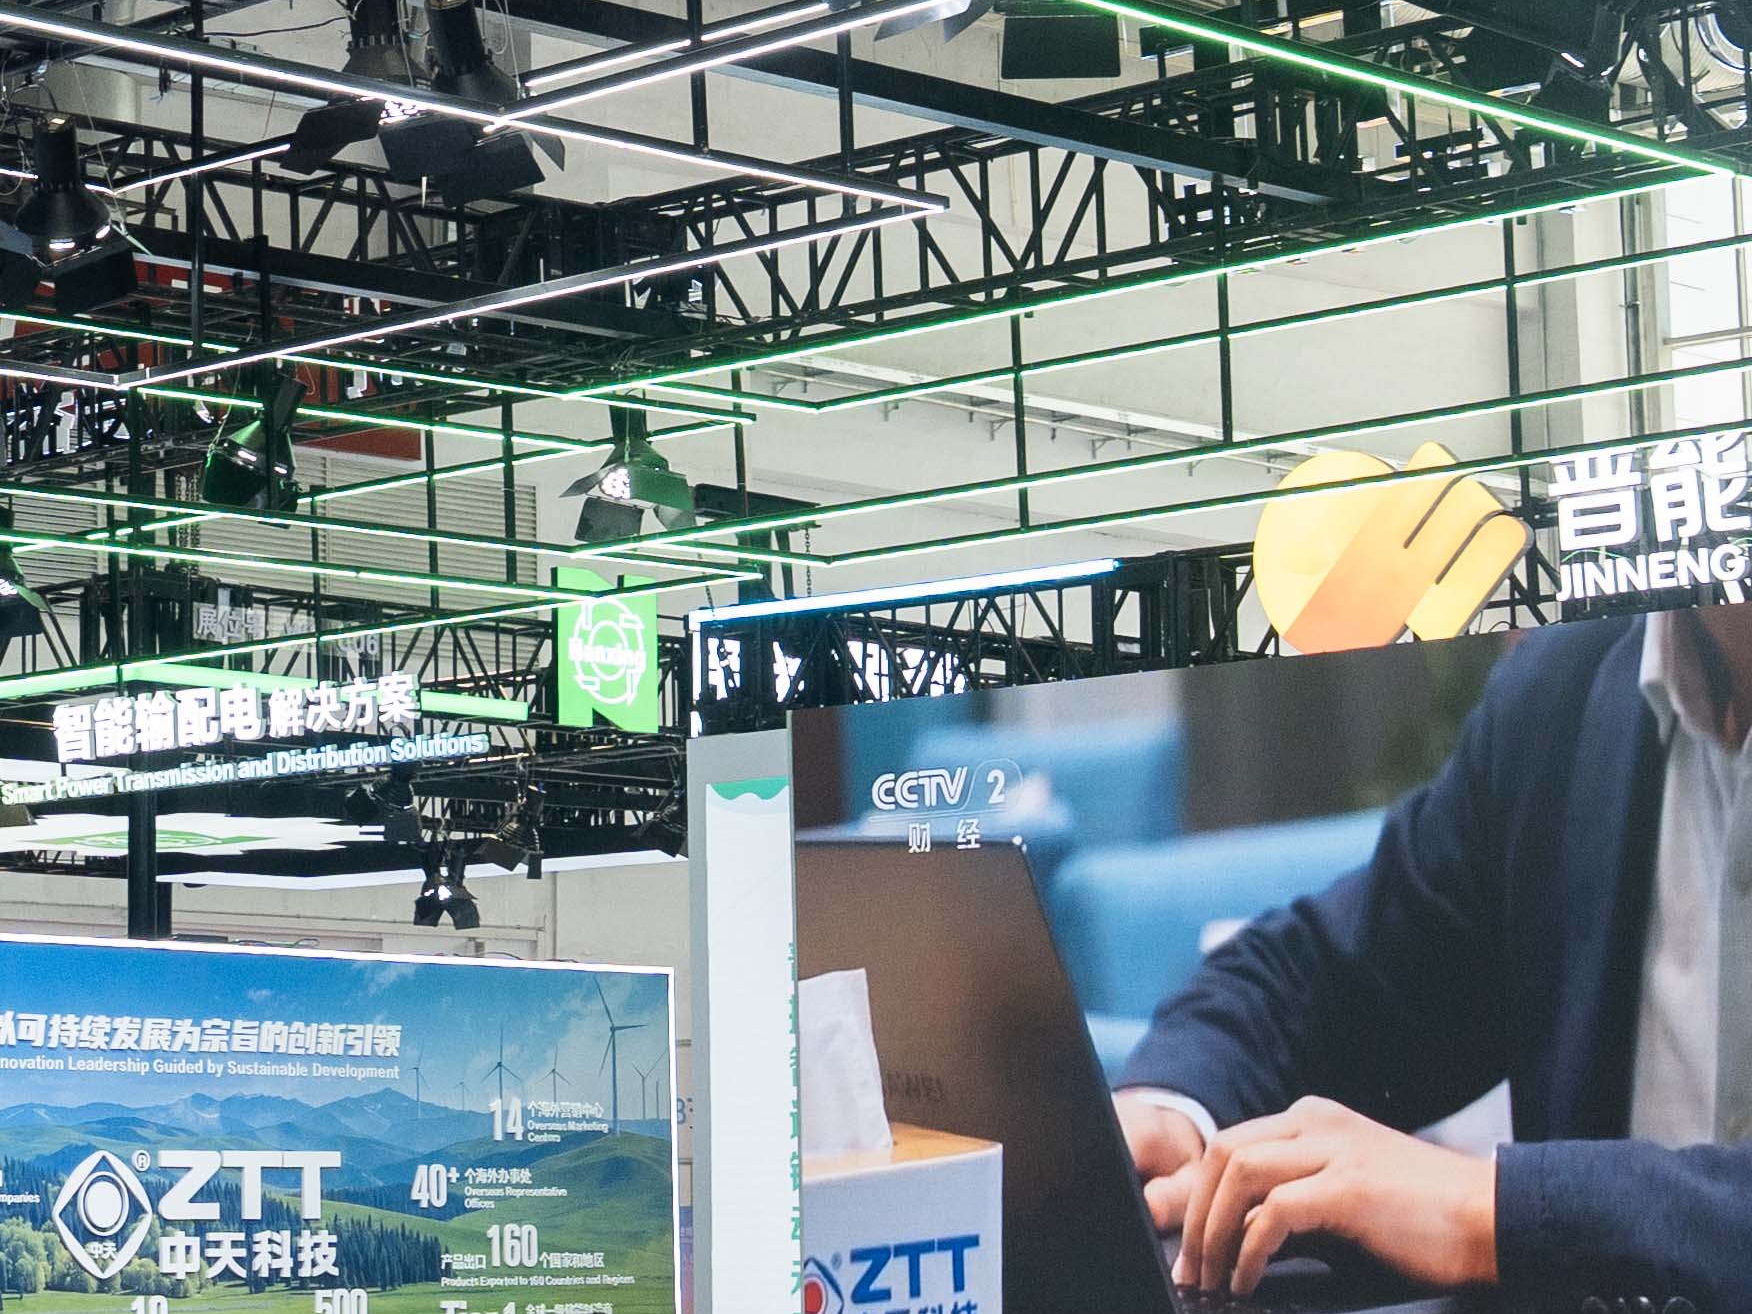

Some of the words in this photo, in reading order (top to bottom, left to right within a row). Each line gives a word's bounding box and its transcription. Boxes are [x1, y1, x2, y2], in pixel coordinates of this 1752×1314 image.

[1555, 545, 1746, 604] JINNENG
[53, 683, 263, 763] 智能输配电
[268, 671, 421, 738] 解决方案
[2, 782, 53, 806] Smart
[56, 773, 114, 800] Power
[117, 760, 233, 793] Transmission
[237, 754, 274, 780] and
[276, 743, 388, 775] Distribution
[390, 731, 490, 762] Solutions
[872, 766, 968, 810] CCTV
[987, 769, 1006, 804] 2
[908, 818, 981, 854] 财经
[67, 1056, 151, 1077] Leadership
[153, 1058, 204, 1075] Guided
[207, 1061, 225, 1079] by
[227, 1061, 309, 1078] Sustainable
[311, 1062, 400, 1081] Development
[489, 1097, 524, 1141] 14
[157, 1150, 342, 1221] ZTT
[411, 1164, 460, 1208] 40+
[464, 1167, 532, 1185] 个海外办事处
[90, 1241, 117, 1261] 中天
[158, 1230, 339, 1280] 中天科技
[441, 1253, 486, 1270] 产品出口
[486, 1224, 538, 1269] 160
[539, 1252, 604, 1269] 个国家和地区
[850, 1234, 980, 1305] ZTT
